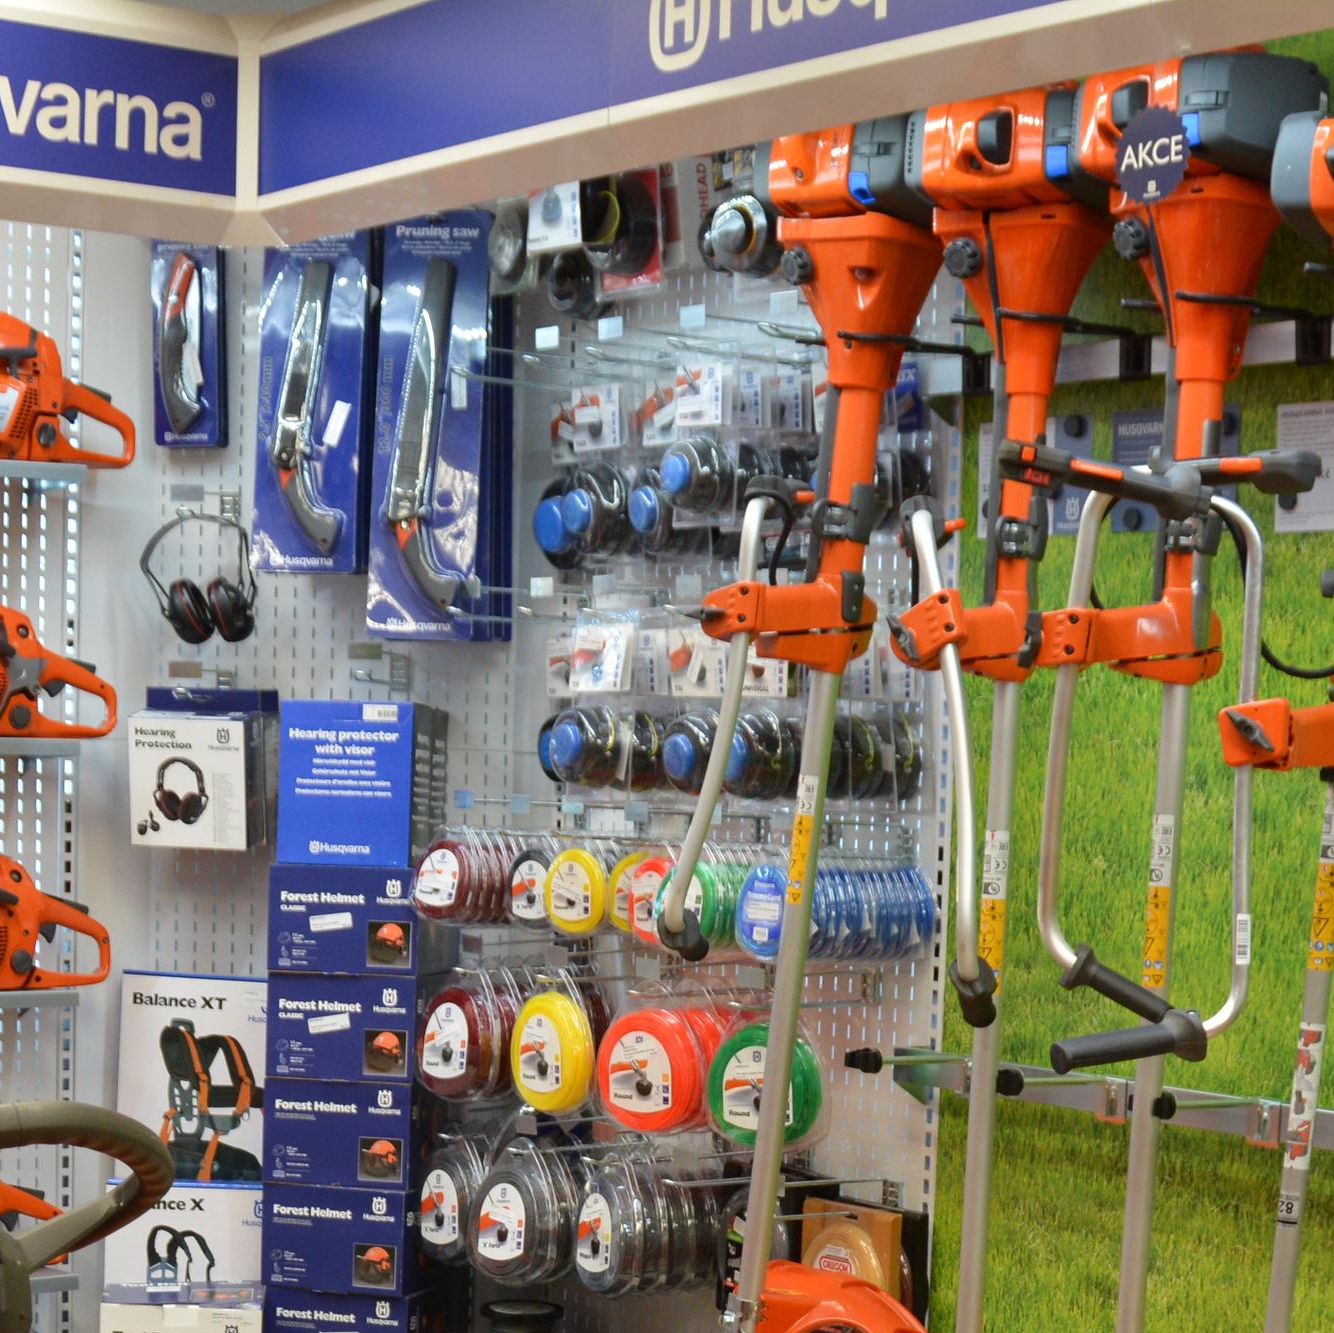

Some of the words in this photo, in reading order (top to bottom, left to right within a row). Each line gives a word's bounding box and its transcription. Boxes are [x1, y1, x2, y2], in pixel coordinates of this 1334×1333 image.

[1120, 134, 1183, 172] AKCE
[396, 225, 448, 239] Pruning
[452, 226, 479, 238] saw
[282, 554, 333, 567] Husqvarna
[135, 726, 176, 738] Hearing
[289, 727, 336, 741] Hearing
[339, 729, 399, 742] protector
[135, 738, 192, 750] Protection
[315, 743, 343, 755] with
[345, 744, 375, 756] visor
[319, 841, 370, 855] Husqvarna
[280, 891, 318, 904] Forest
[320, 892, 365, 905] Helmet
[133, 992, 197, 1009] Balance
[201, 996, 227, 1010] XT
[279, 998, 316, 1011] Forest
[318, 1000, 361, 1013] Helmet
[373, 1005, 406, 1014] Husqvarna
[613, 1092, 633, 1100] Round
[275, 1098, 312, 1111] Forest
[314, 1100, 357, 1113] Helmet
[729, 1109, 750, 1117] Round
[190, 1199, 204, 1211] X
[273, 1203, 310, 1216] Forest
[311, 1207, 352, 1220] Helmet
[823, 1259, 849, 1272] OREGON
[276, 1306, 311, 1320] Forest
[313, 1310, 356, 1323] Helmet
